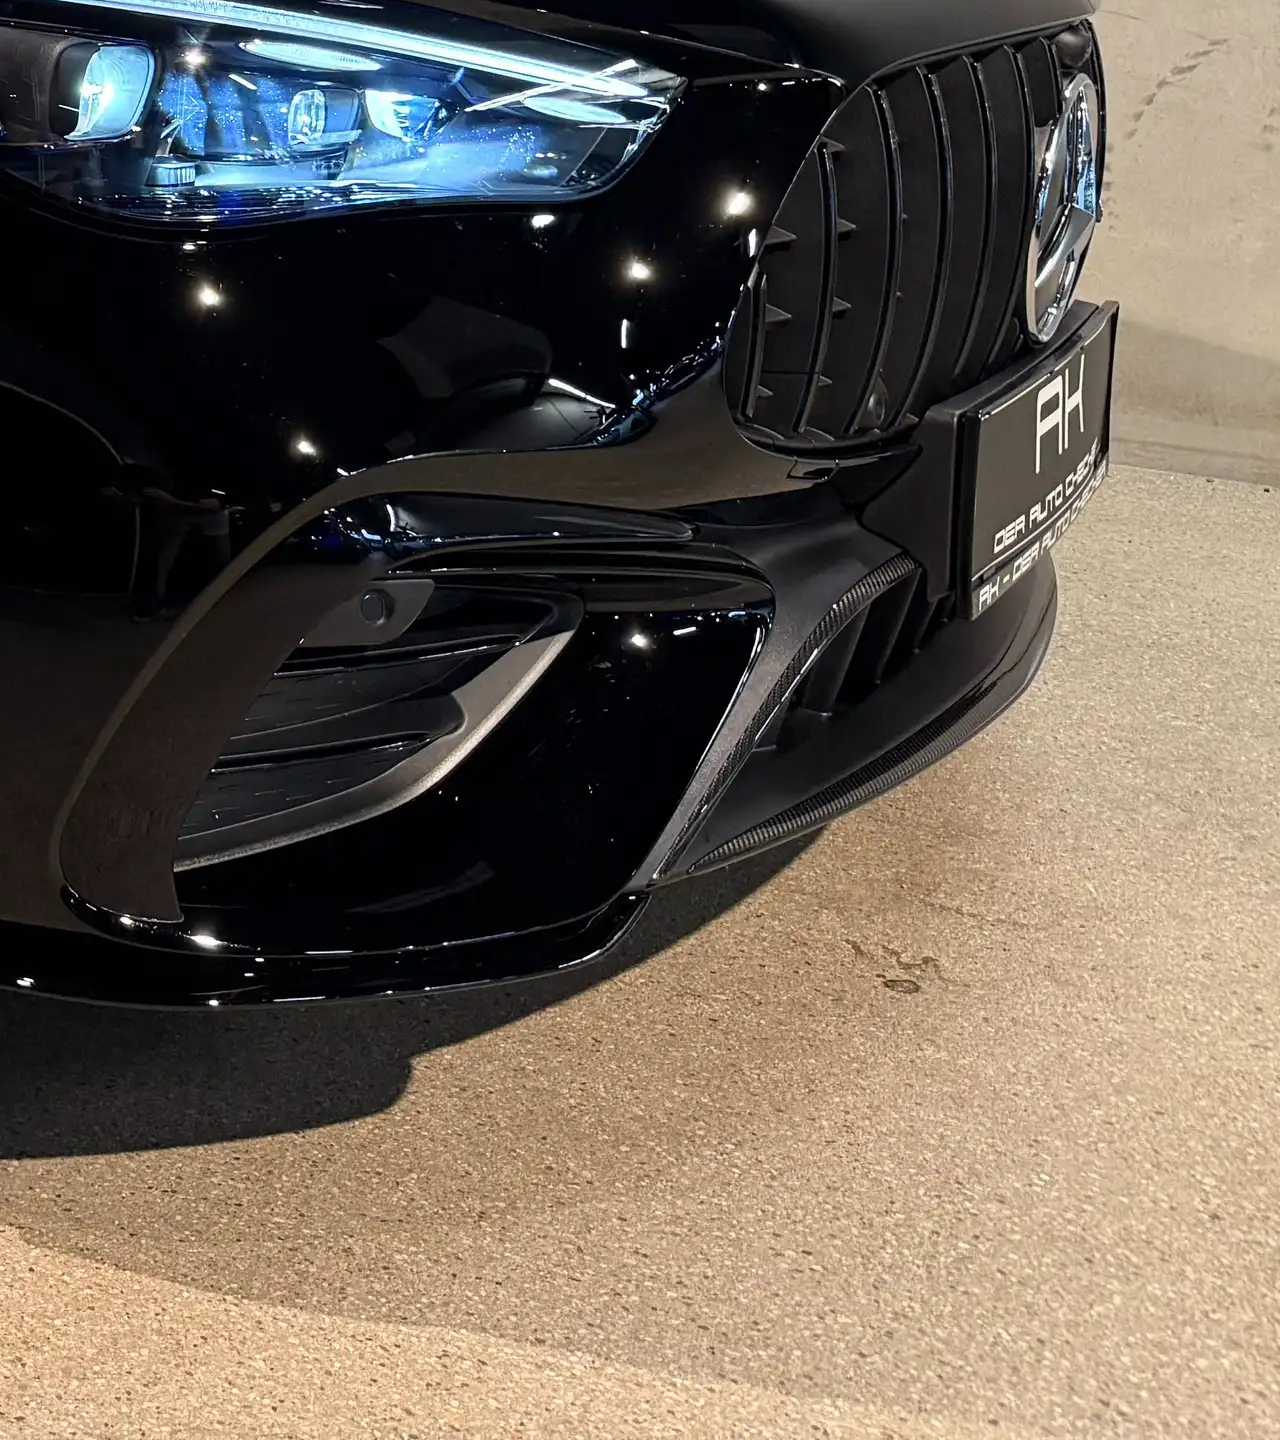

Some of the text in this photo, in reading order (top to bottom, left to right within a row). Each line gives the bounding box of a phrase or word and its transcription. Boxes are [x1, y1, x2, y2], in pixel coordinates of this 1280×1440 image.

[1035, 354, 1085, 474] AK
[993, 513, 1025, 555] DER
[1028, 483, 1063, 529] AUTO
[978, 575, 1000, 612] AK
[1012, 541, 1040, 580] DER
